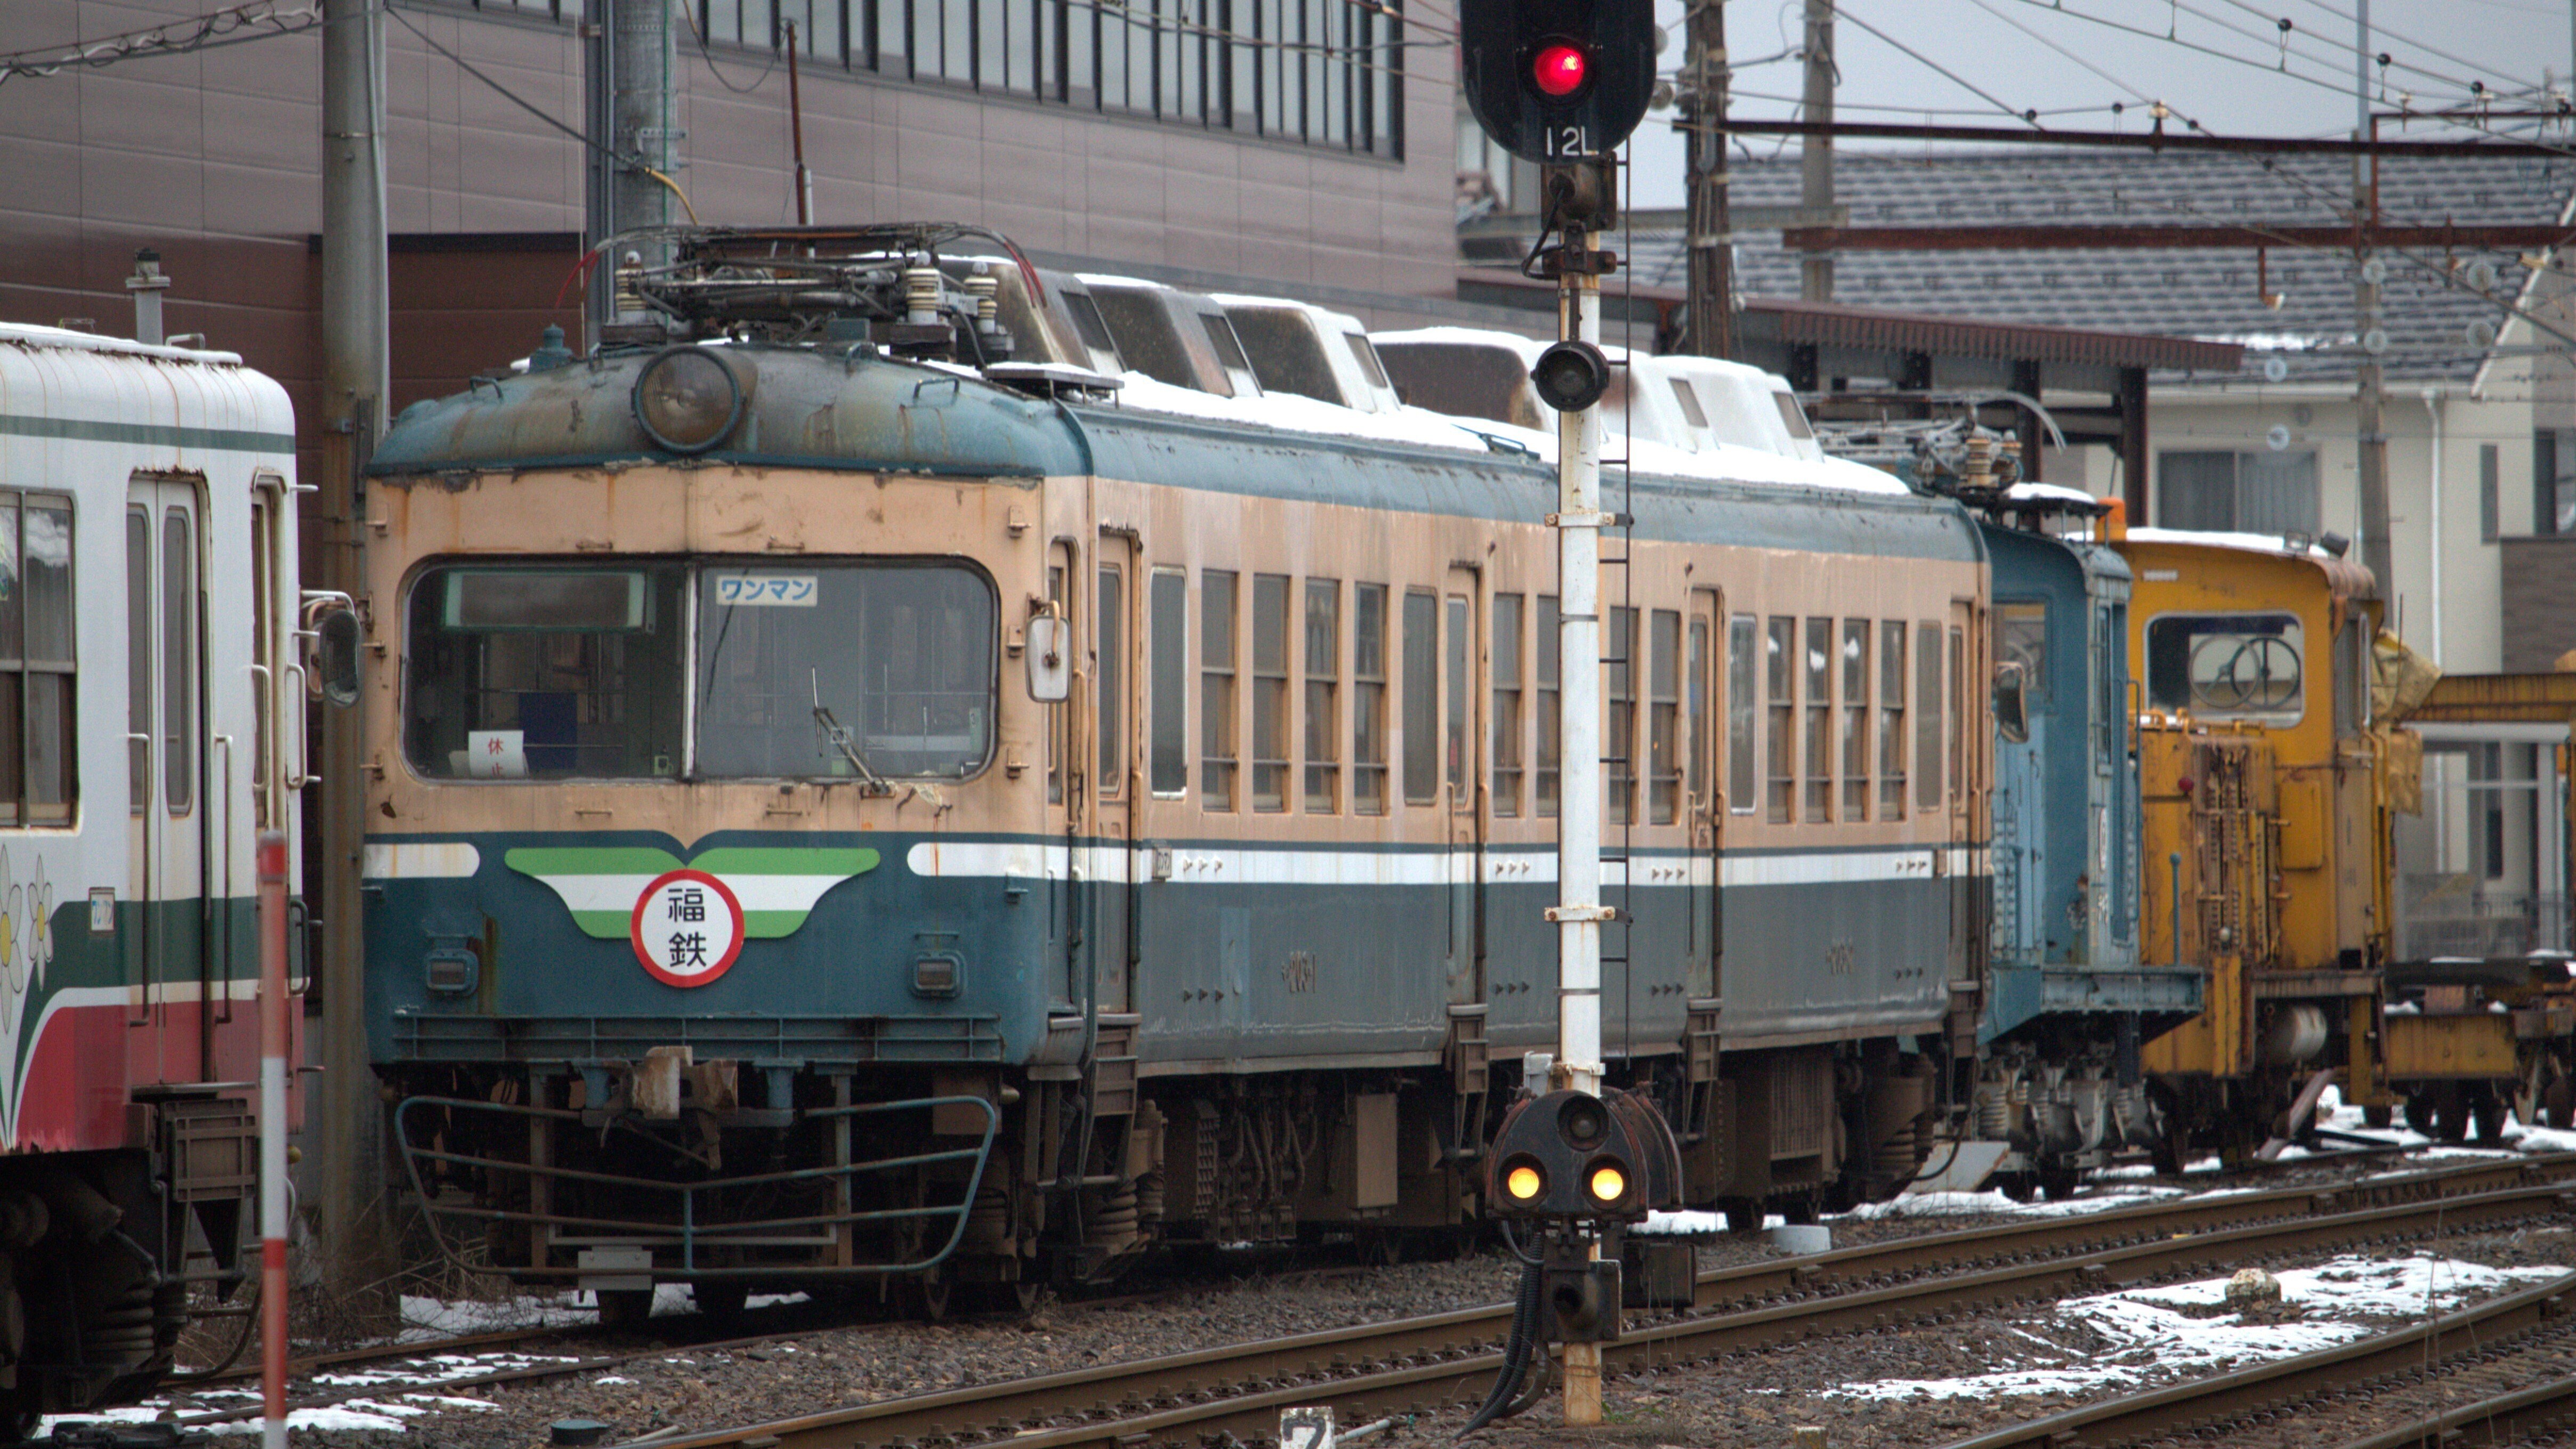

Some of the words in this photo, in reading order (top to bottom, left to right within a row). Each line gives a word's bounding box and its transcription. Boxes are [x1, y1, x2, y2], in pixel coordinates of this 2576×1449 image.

[1547, 126, 1599, 156] 12L
[722, 580, 812, 601] ワンマン
[667, 888, 707, 967] 福鉄
